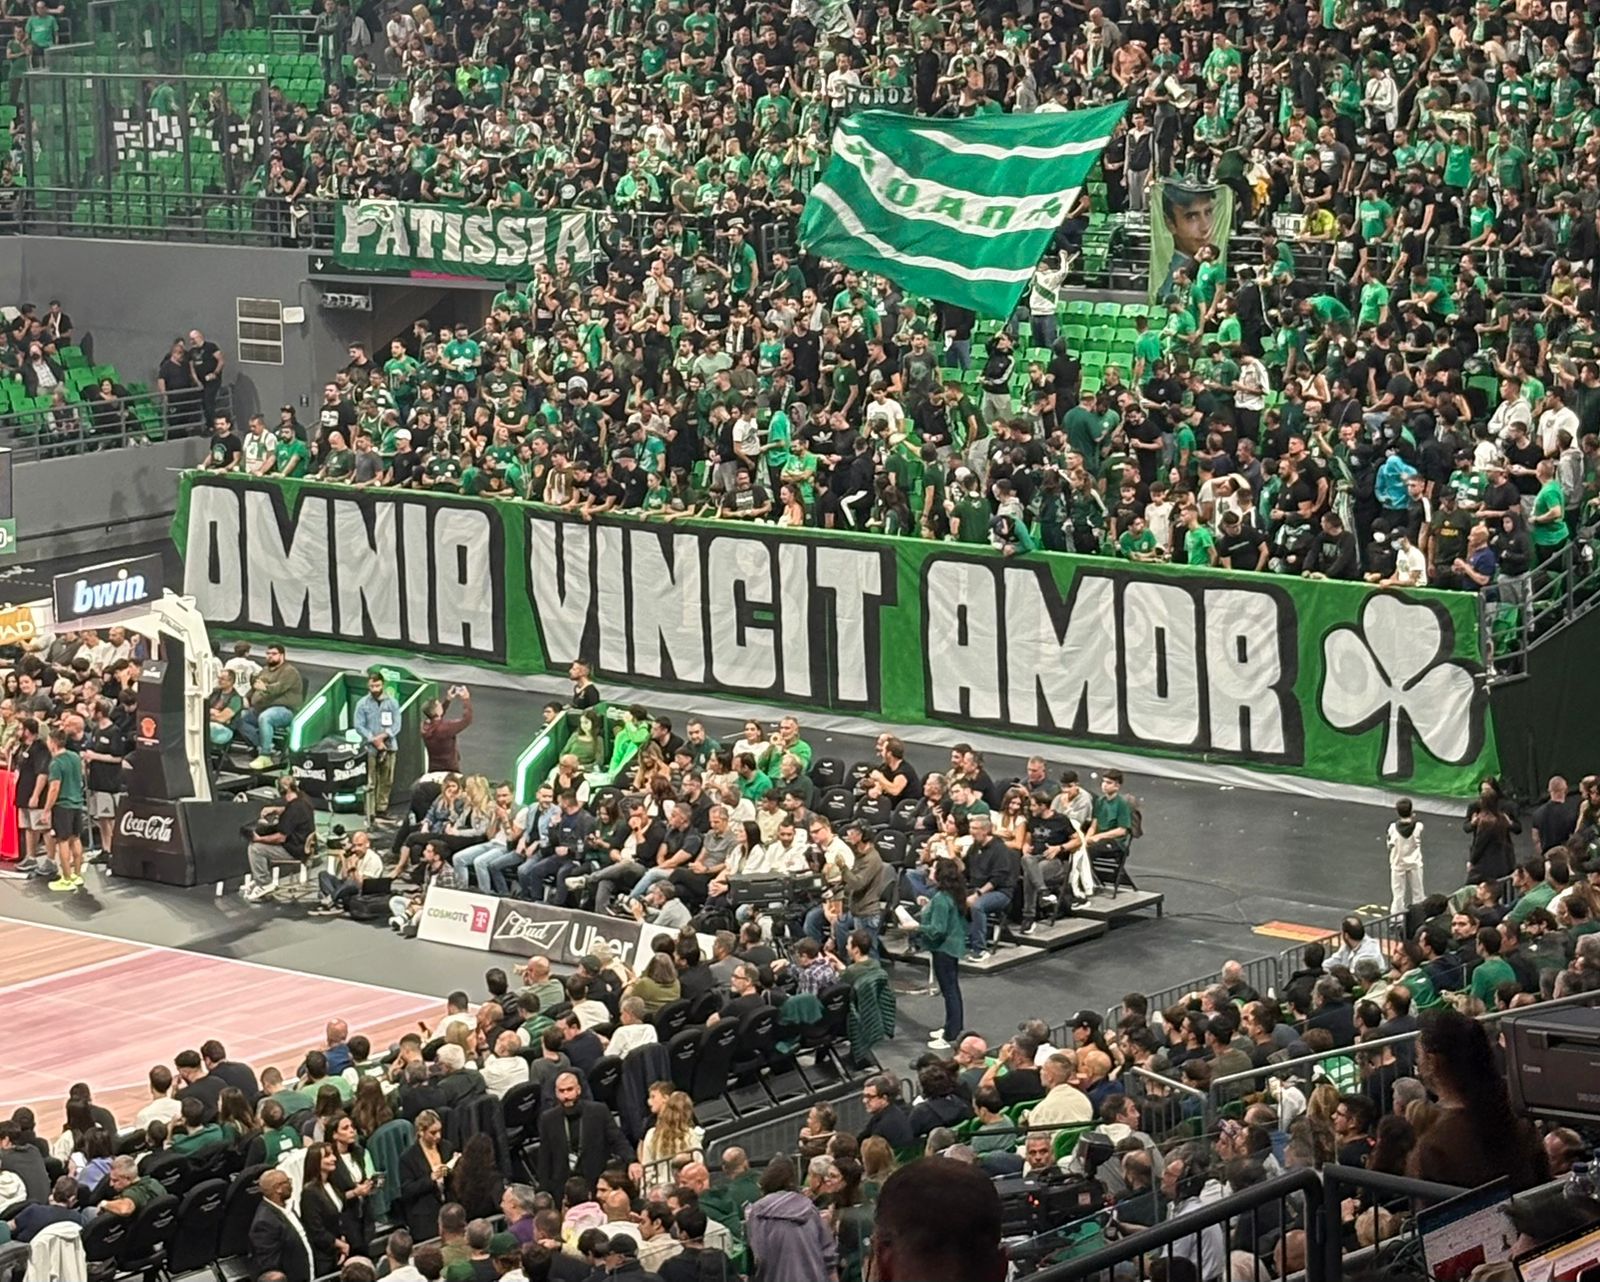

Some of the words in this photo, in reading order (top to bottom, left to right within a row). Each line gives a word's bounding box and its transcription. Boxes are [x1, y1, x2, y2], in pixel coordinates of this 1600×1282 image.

[341, 203, 592, 266] PATISSIA
[182, 484, 495, 653] OMNIA
[529, 518, 882, 702] VINCIT
[926, 560, 1286, 755] AMOR
[120, 810, 175, 843] Coca-Cola
[509, 917, 547, 941] Bud
[569, 922, 634, 963] Uber
